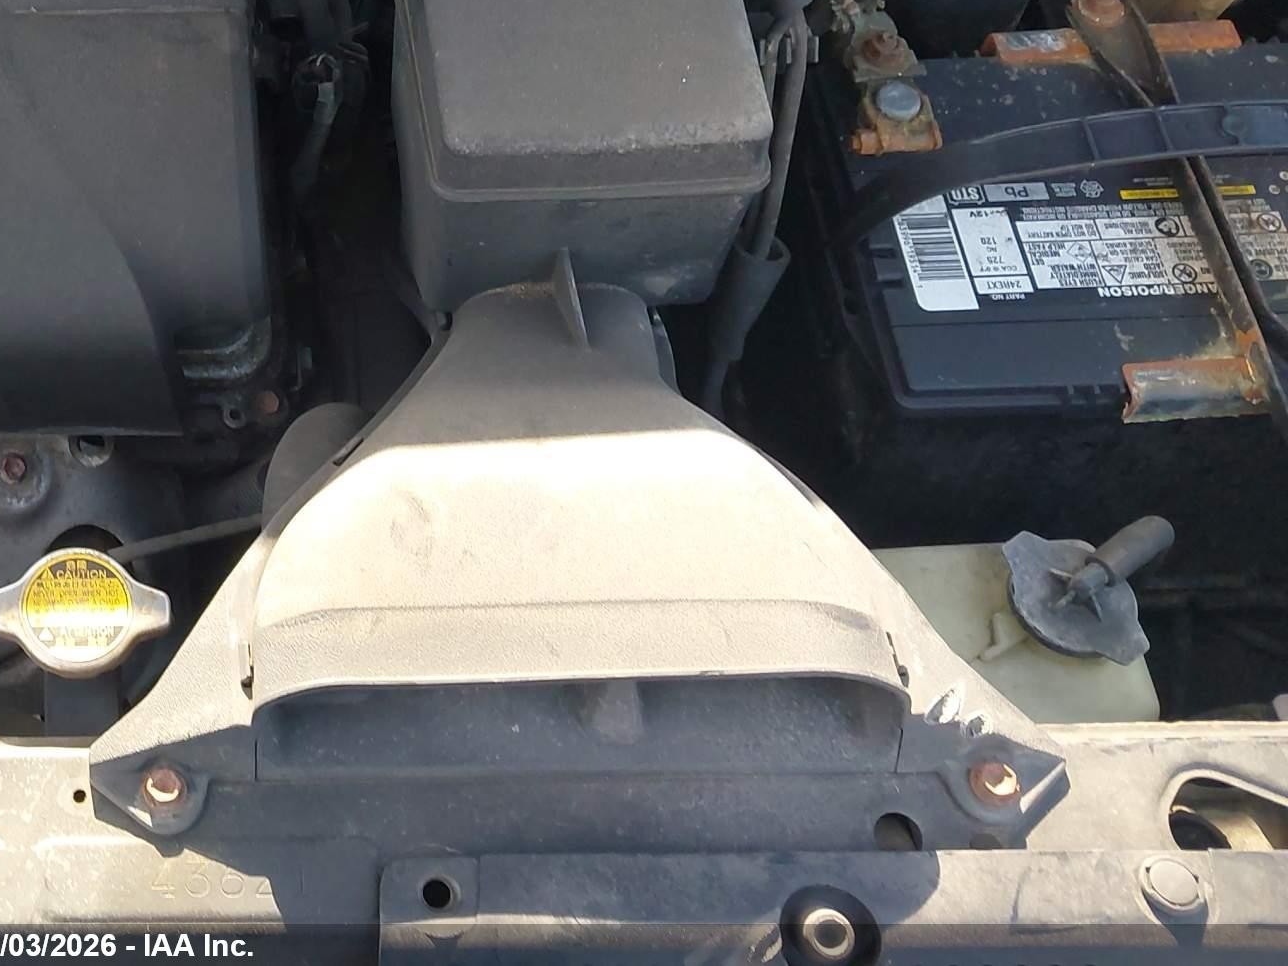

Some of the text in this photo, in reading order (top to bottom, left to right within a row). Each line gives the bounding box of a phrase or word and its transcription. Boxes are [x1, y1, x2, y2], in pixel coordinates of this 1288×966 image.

[1004, 186, 1029, 197] Pb
[1097, 283, 1217, 297] ANGER/POISON
[1006, 292, 1025, 300] PART
[56, 569, 107, 579] CAUTION
